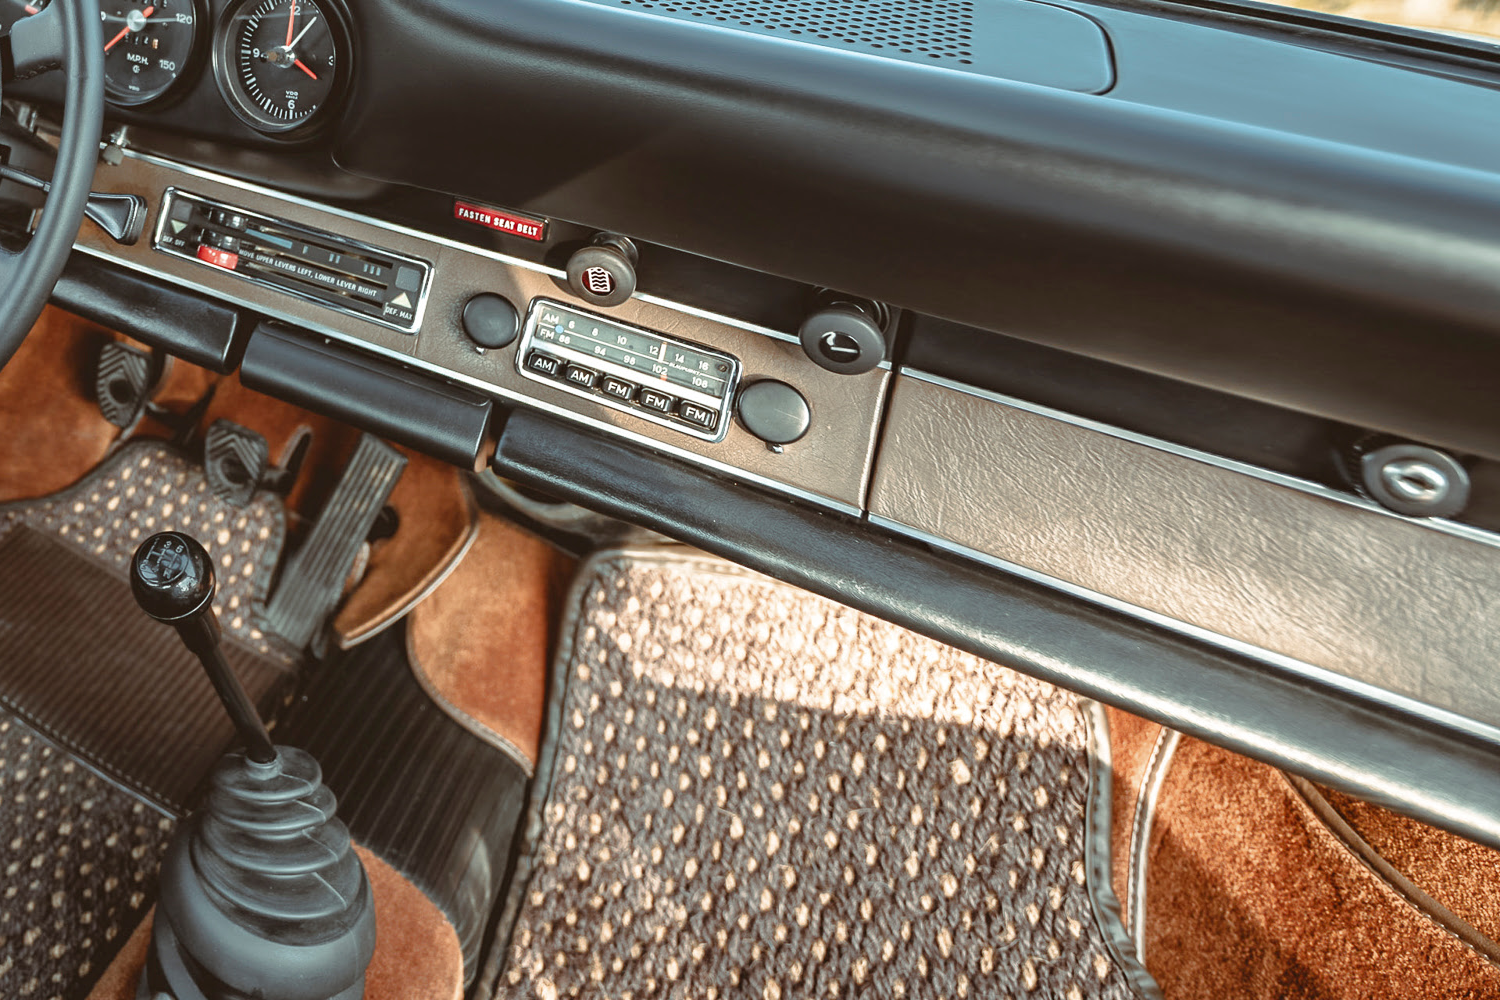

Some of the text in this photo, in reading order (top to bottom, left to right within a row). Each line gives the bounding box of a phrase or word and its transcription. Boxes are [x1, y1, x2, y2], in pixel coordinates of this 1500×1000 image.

[176, 12, 192, 24] 120
[252, 48, 260, 58] 9
[160, 60, 176, 70] 150
[288, 100, 295, 110] 6
[458, 208, 538, 236] FASTEN SEAT BELT
[238, 249, 378, 296] MOVE UPPER LEVERS LEFT, LOWER LEVER RIGHT
[400, 310, 412, 320] MAX
[543, 313, 708, 370] AM 6 8 10 12 14 16
[534, 358, 552, 370] AM
[540, 328, 554, 339] FM
[594, 346, 606, 356] 94
[624, 355, 636, 365] 98
[652, 364, 668, 375] 102
[692, 376, 708, 388] 108
[570, 370, 590, 384] AM
[608, 383, 627, 396] FM
[646, 396, 666, 409] FM
[685, 406, 706, 420] FM
